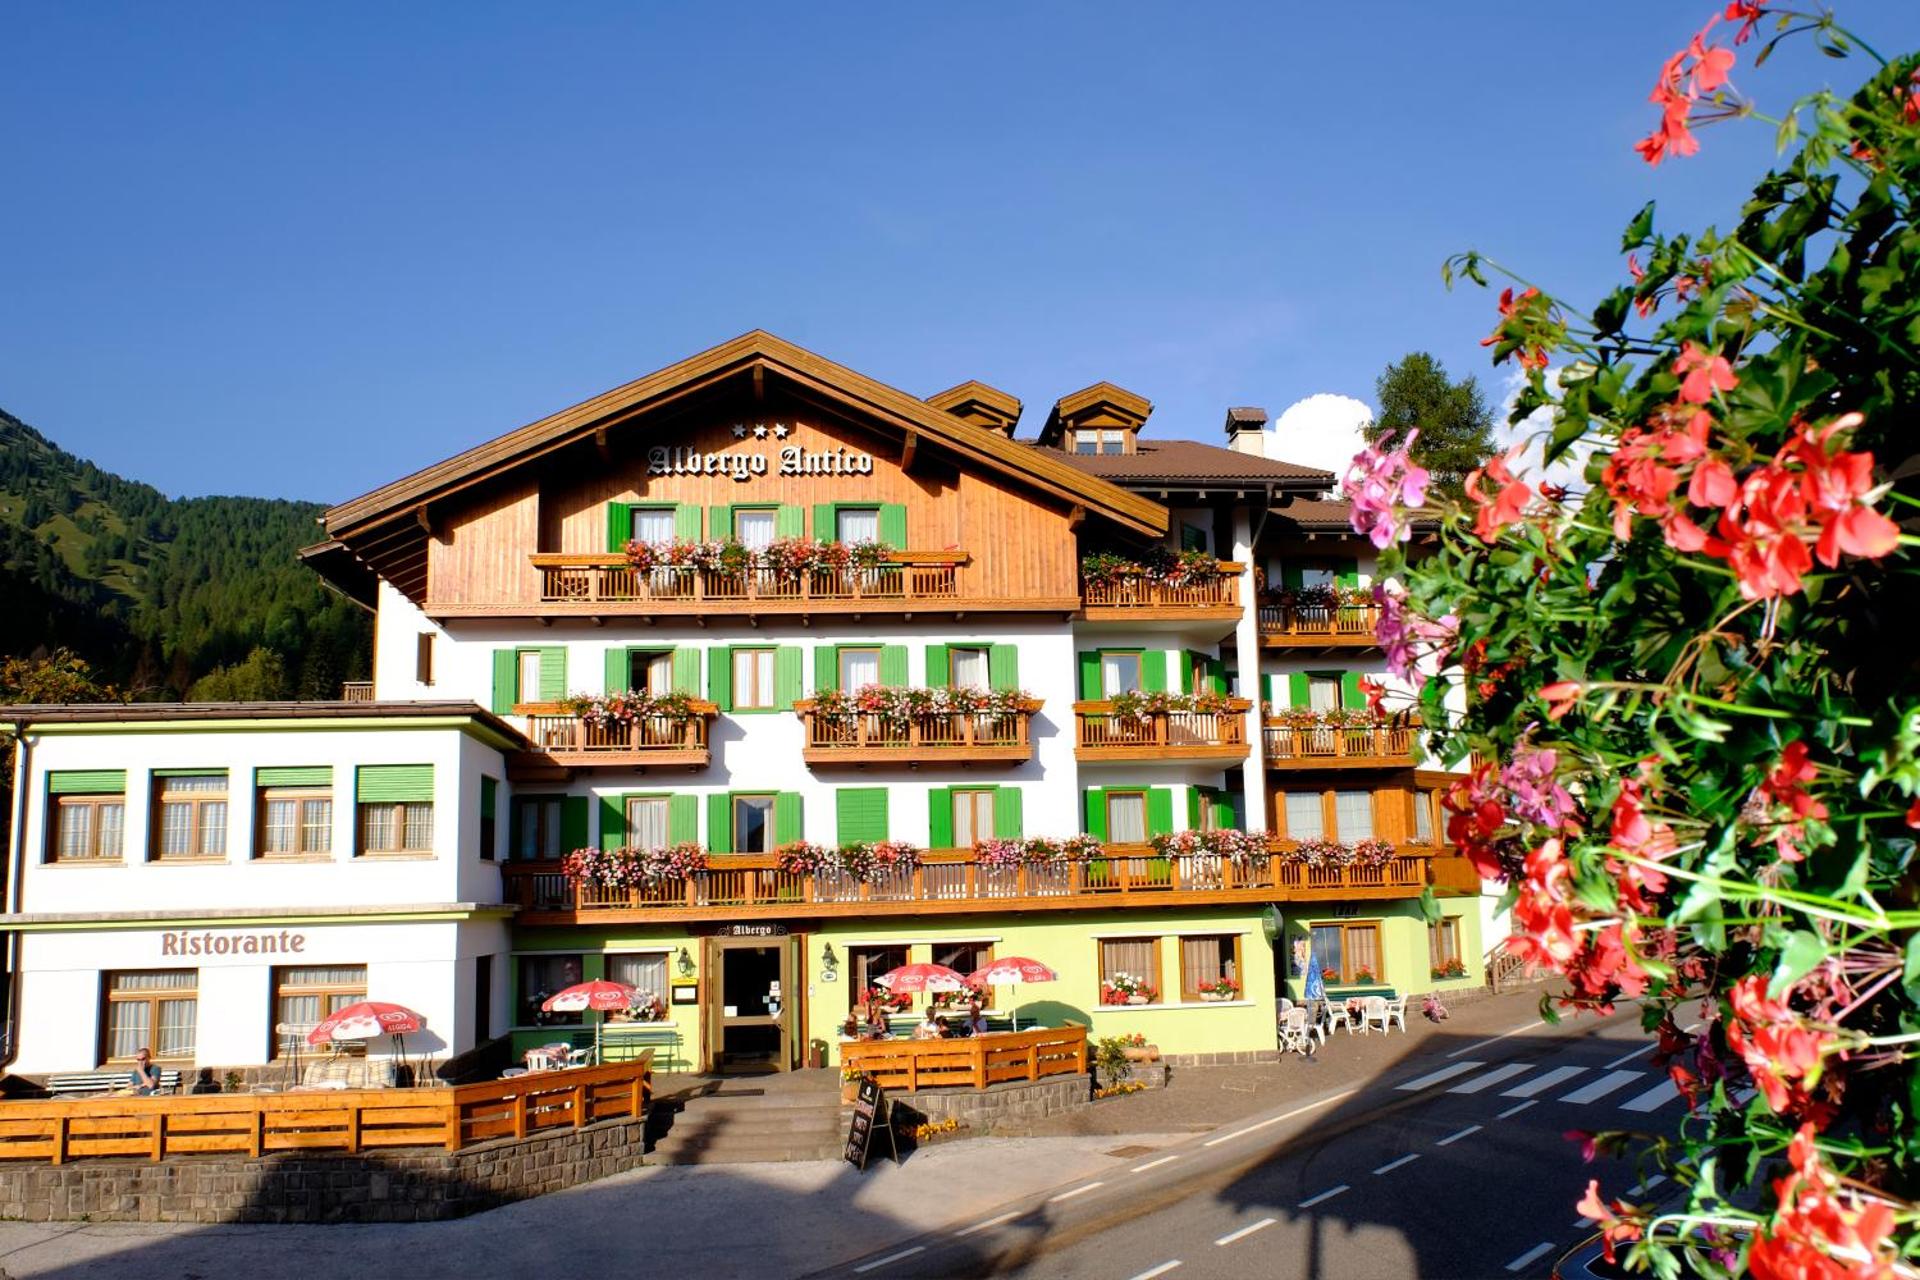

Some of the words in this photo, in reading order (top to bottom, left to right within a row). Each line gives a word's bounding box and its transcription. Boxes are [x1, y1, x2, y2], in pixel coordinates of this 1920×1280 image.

[647, 446, 768, 480] Albergo
[778, 445, 873, 475] Antico
[161, 930, 305, 956] Ristorante
[733, 924, 772, 936] Albergo
